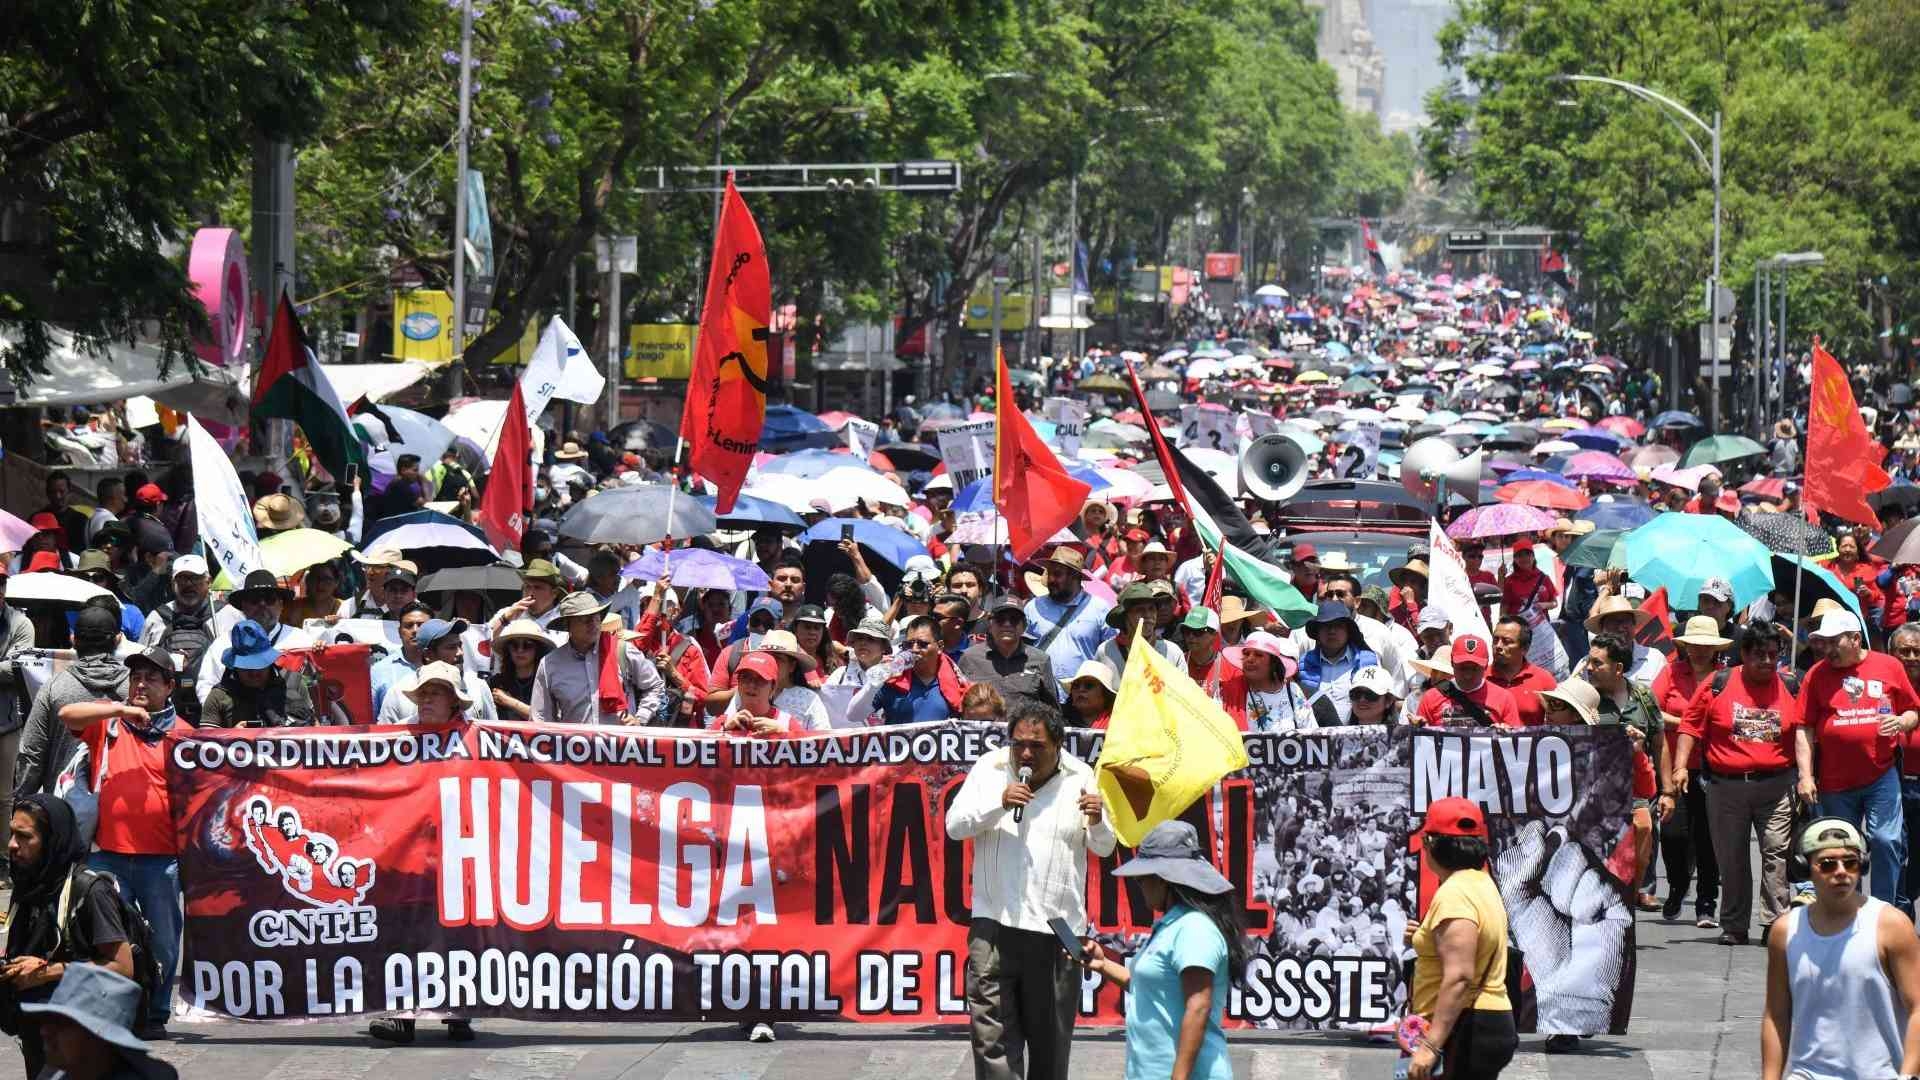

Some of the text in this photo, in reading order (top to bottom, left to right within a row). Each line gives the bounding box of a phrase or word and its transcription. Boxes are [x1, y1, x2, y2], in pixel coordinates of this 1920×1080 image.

[173, 729, 469, 769] COORDINADORA
[480, 731, 662, 765] NACIONAL
[676, 739, 716, 765] DE
[1413, 735, 1573, 814] MAYO
[438, 776, 777, 927] HUELGA
[251, 908, 377, 945] CNTE
[194, 960, 285, 1016] POR
[305, 956, 364, 1014] LA
[385, 939, 674, 1011] ABROGACIÓN
[694, 954, 839, 1011] TOTAL
[859, 954, 919, 1011] DE
